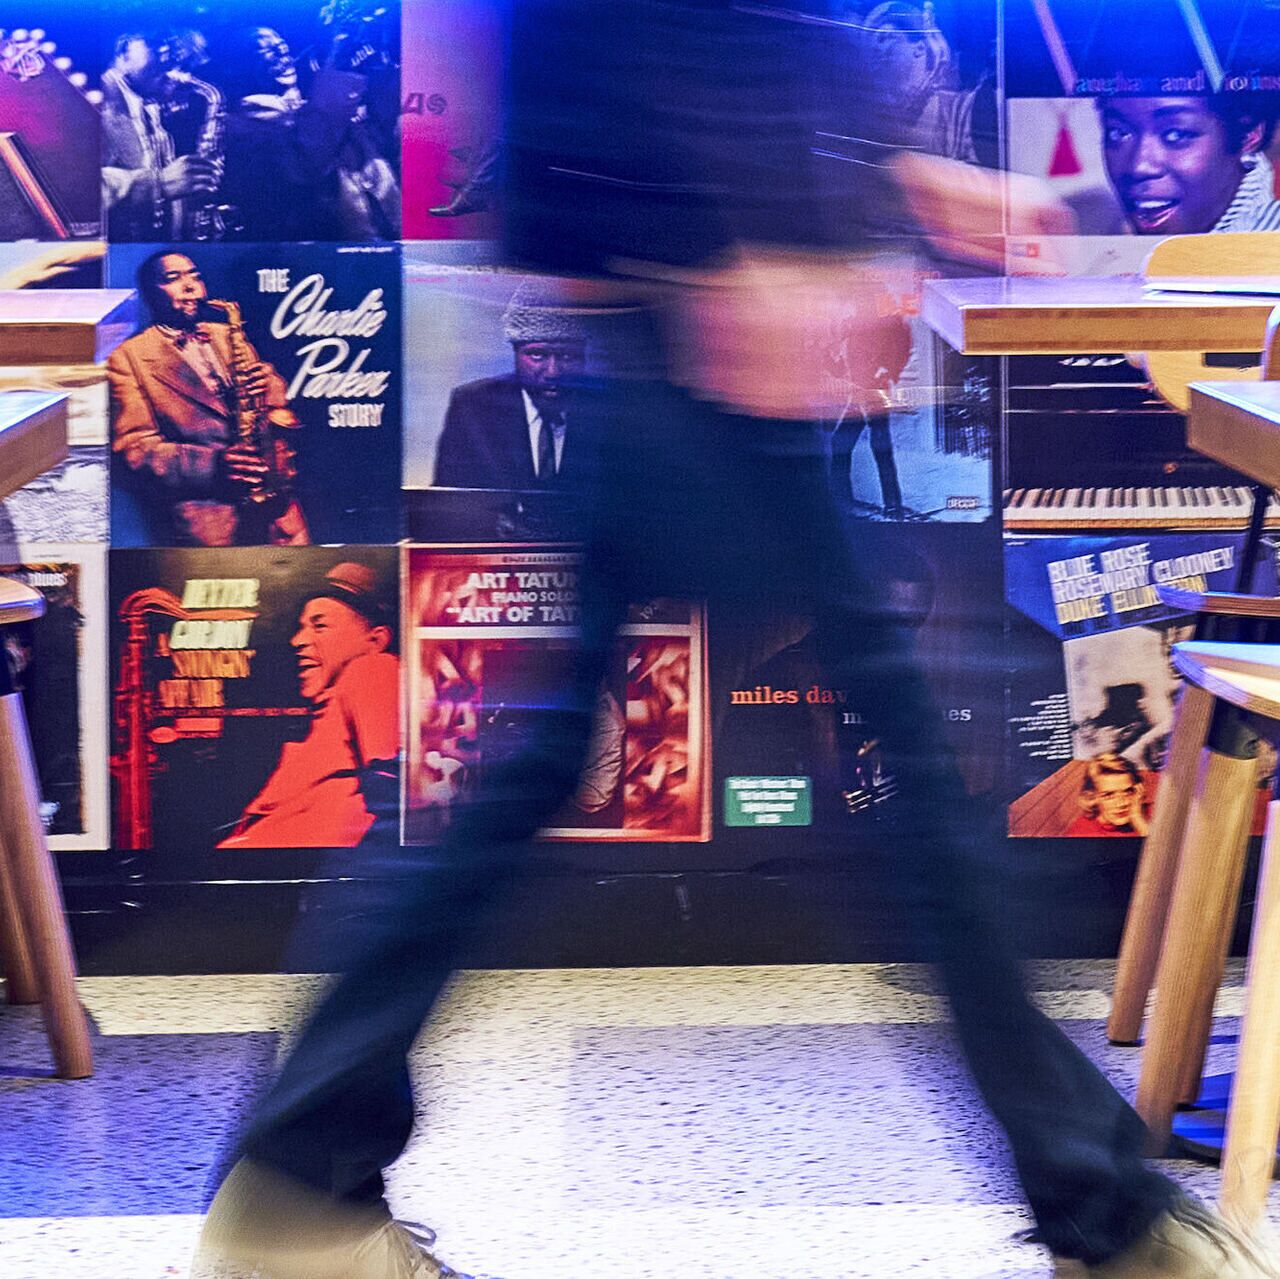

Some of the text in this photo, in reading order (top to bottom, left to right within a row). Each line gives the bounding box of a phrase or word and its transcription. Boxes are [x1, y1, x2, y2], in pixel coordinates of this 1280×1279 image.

[256, 269, 291, 293] THE
[270, 273, 388, 339] Charlie
[285, 338, 391, 401] Parker
[328, 403, 385, 428] STORY
[1100, 542, 1152, 573] ROSE
[467, 572, 511, 589] ART
[1051, 546, 1235, 604] ROSEMARY CLOONEY
[491, 591, 537, 603] PIANO
[1055, 595, 1108, 624] DUKE
[506, 606, 535, 622] OF
[730, 685, 849, 705] miles dav
